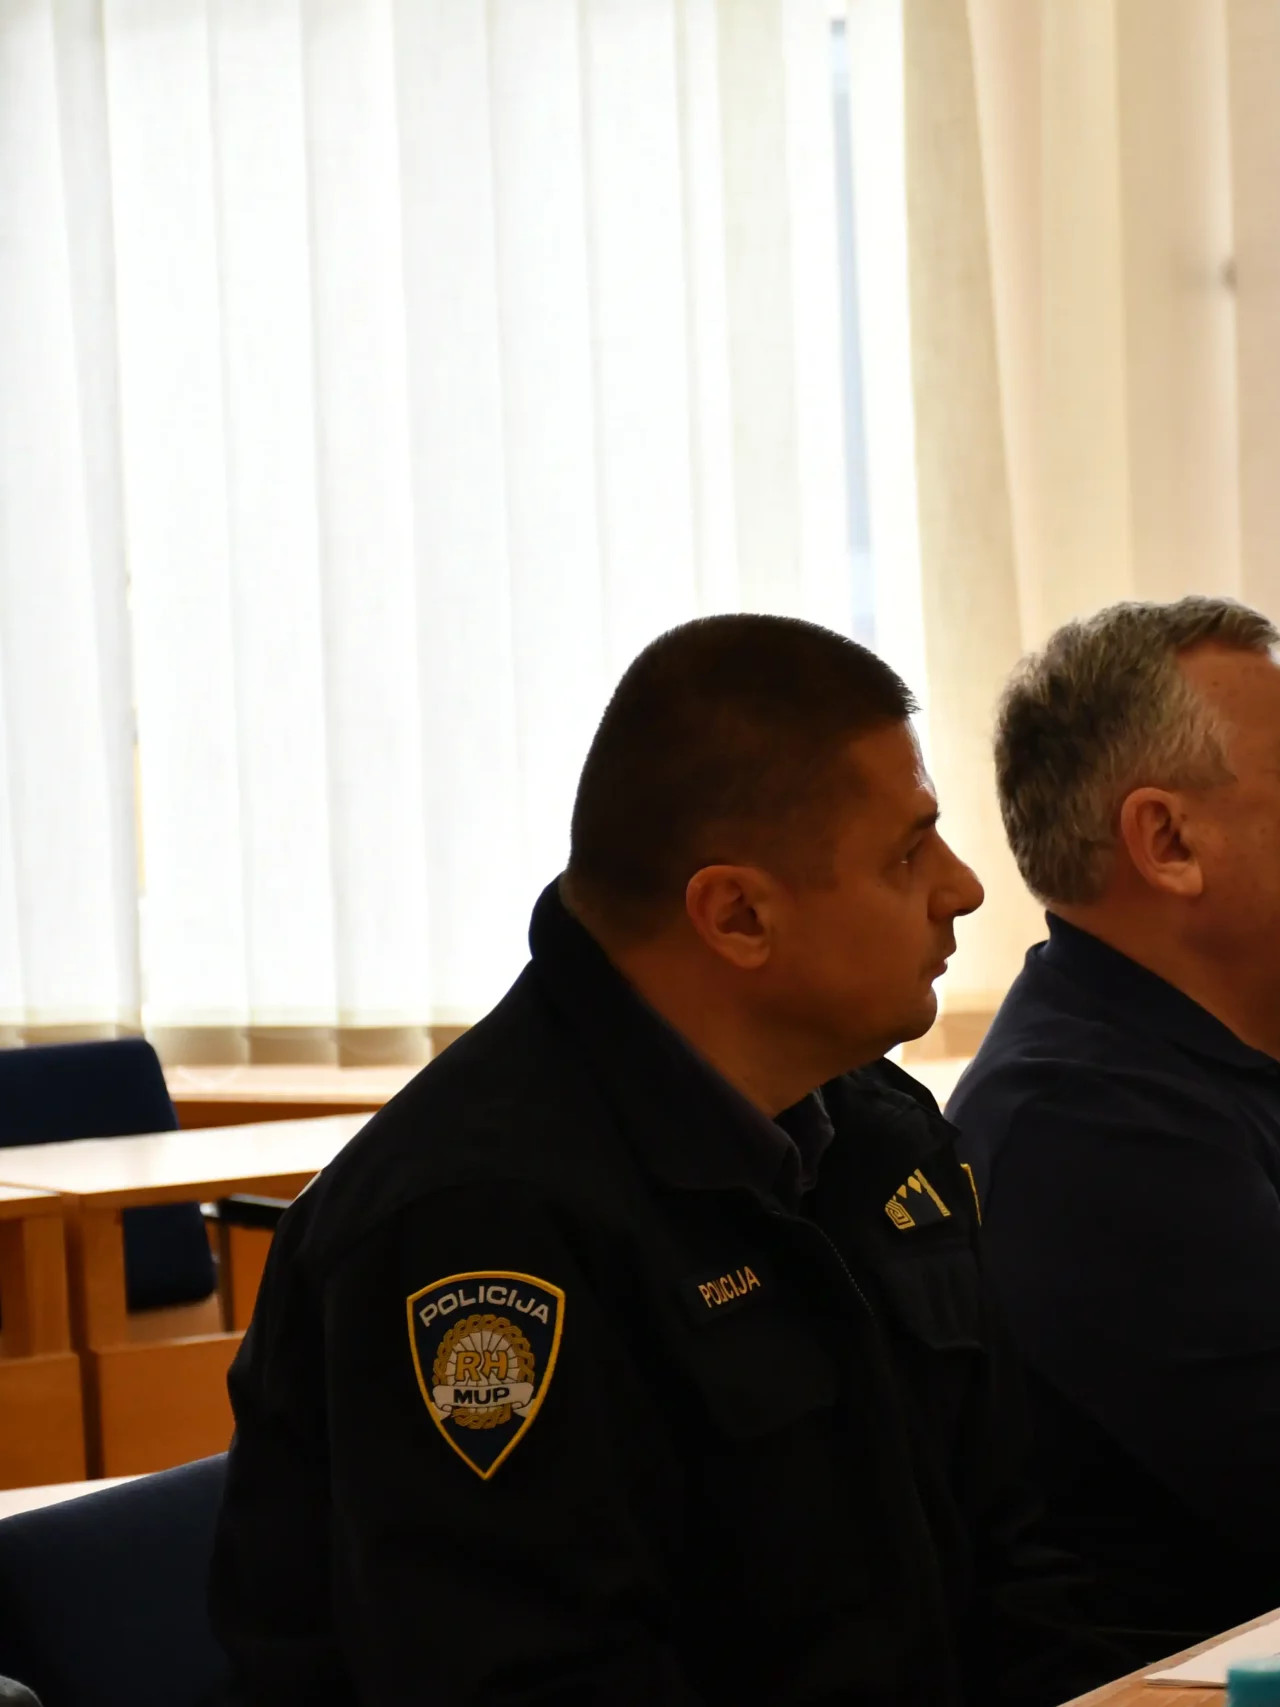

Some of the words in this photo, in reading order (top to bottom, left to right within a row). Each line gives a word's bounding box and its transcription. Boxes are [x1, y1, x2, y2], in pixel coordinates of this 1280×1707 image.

[697, 1265, 762, 1309] POLICIJA
[418, 1285, 550, 1328] POLICIJA
[454, 1350, 510, 1382] RH
[453, 1387, 511, 1405] MUP
